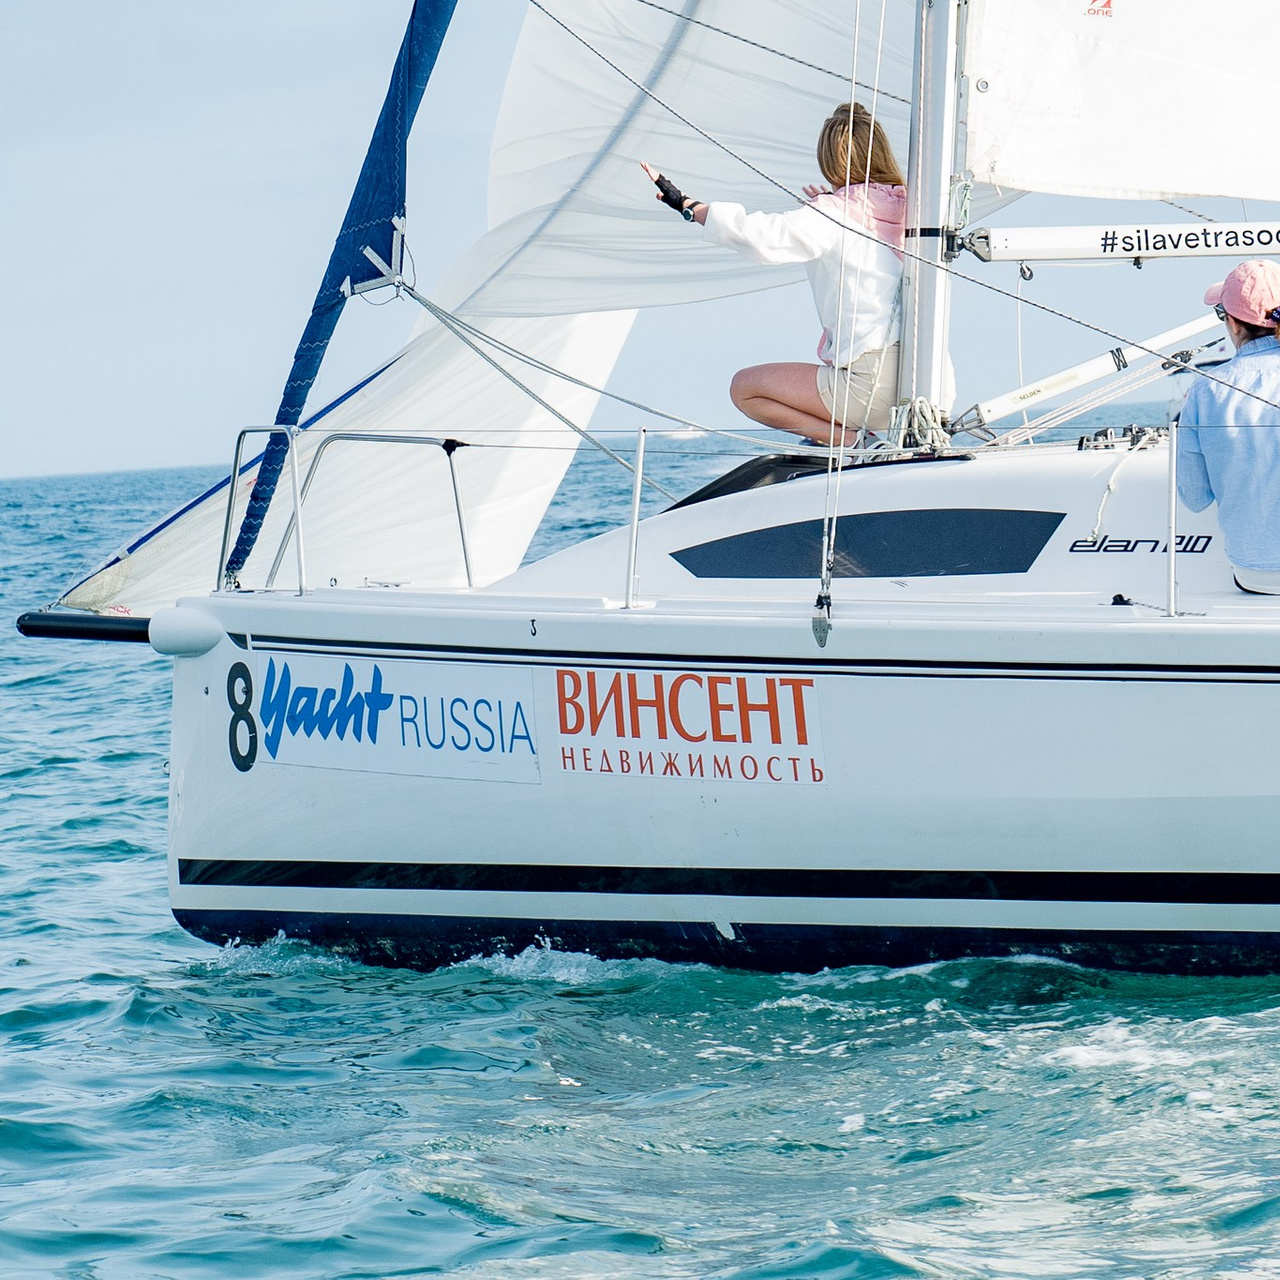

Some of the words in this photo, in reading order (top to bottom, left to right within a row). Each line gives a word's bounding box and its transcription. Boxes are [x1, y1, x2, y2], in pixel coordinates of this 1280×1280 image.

[1069, 534, 1160, 553] elan
[227, 661, 259, 772] 8
[260, 656, 394, 760] Yacht
[400, 695, 536, 755] RUSSIA
[555, 669, 815, 746] ВИНСЕНТ
[561, 746, 825, 784] НЕДВИЖИМОСТЬ
